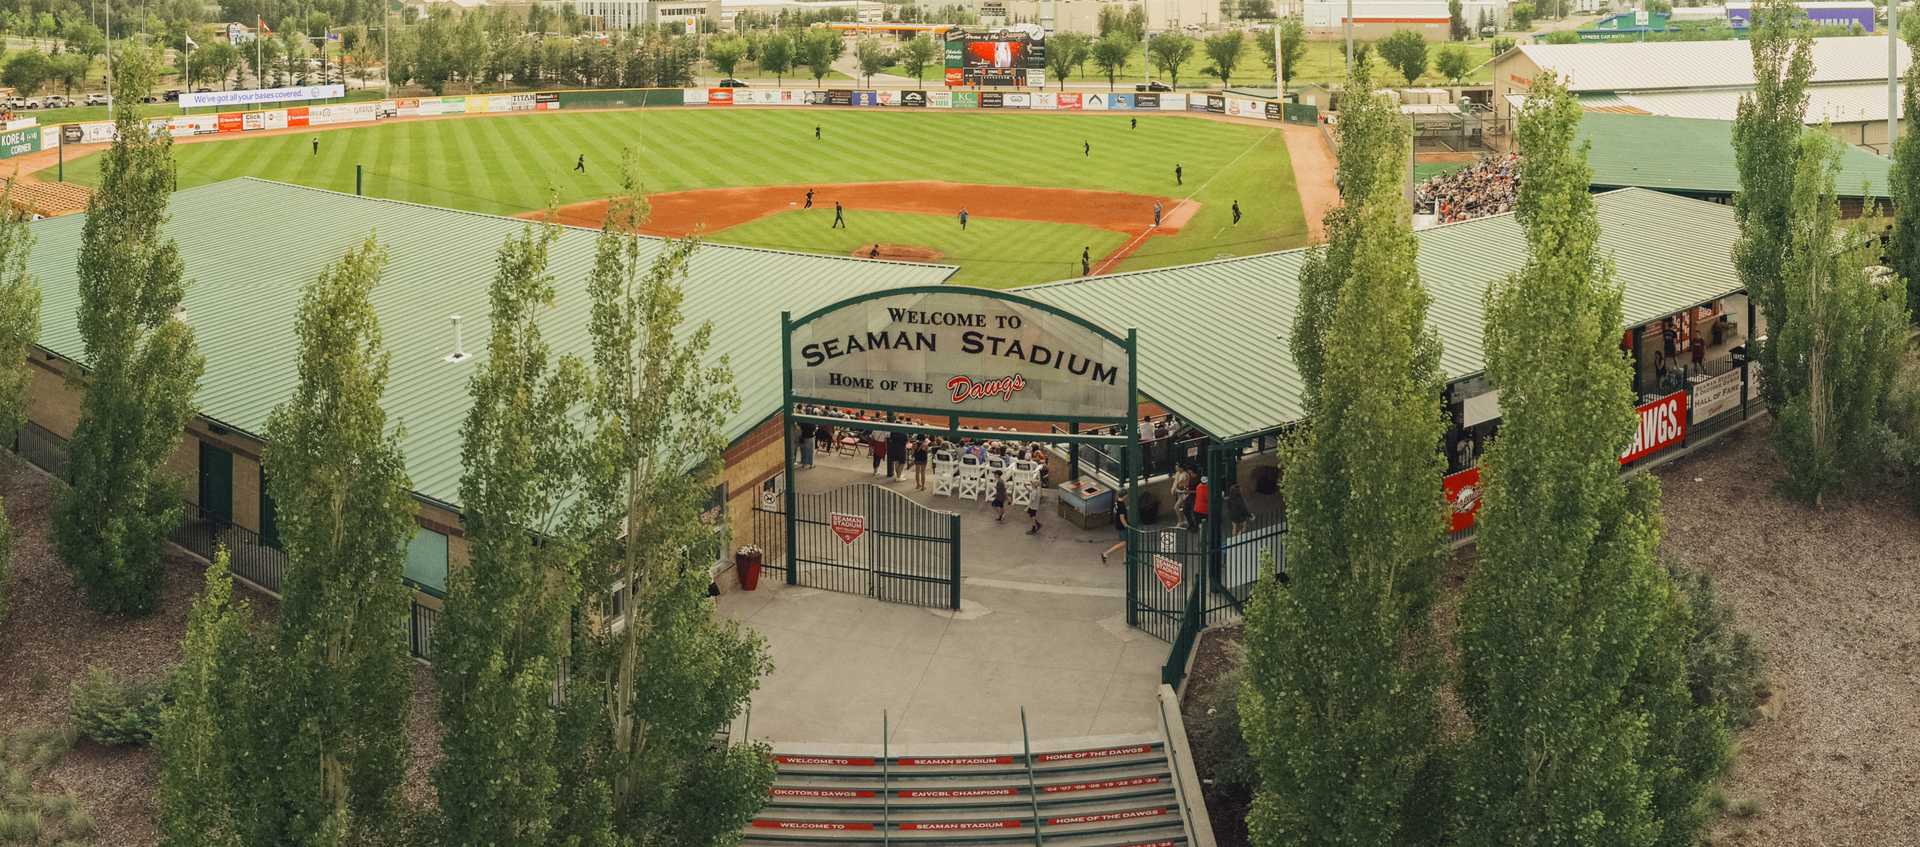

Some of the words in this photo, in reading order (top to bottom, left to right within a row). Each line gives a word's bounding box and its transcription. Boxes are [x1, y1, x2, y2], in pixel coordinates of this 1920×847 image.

[194, 95, 215, 103] We've
[217, 95, 229, 104] got
[230, 93, 238, 101] all
[239, 92, 255, 102] your
[255, 91, 274, 99] bases
[275, 89, 304, 98] covered.
[887, 307, 987, 328] WELCOME
[995, 315, 1022, 329] TO
[801, 331, 936, 367] SEAMAN
[961, 331, 1118, 386] STADIUM
[829, 372, 874, 390] HOME
[880, 379, 898, 391] OF
[904, 382, 934, 394] THE
[946, 373, 1025, 404] Dawgs
[1695, 396, 1712, 408] HALL
[1723, 384, 1740, 396] FAME
[832, 521, 862, 529] STADIUM
[1045, 753, 1073, 761] HOME
[1108, 747, 1144, 755] DAWGS
[786, 757, 832, 765] WELCOME
[774, 789, 820, 797] OKOTOKS
[821, 790, 857, 798] DAWGS
[952, 788, 1009, 797] CHAMPIONS
[1101, 814, 1122, 822] THE
[1123, 810, 1158, 818] DAWGS
[780, 821, 830, 830] WELCOME
